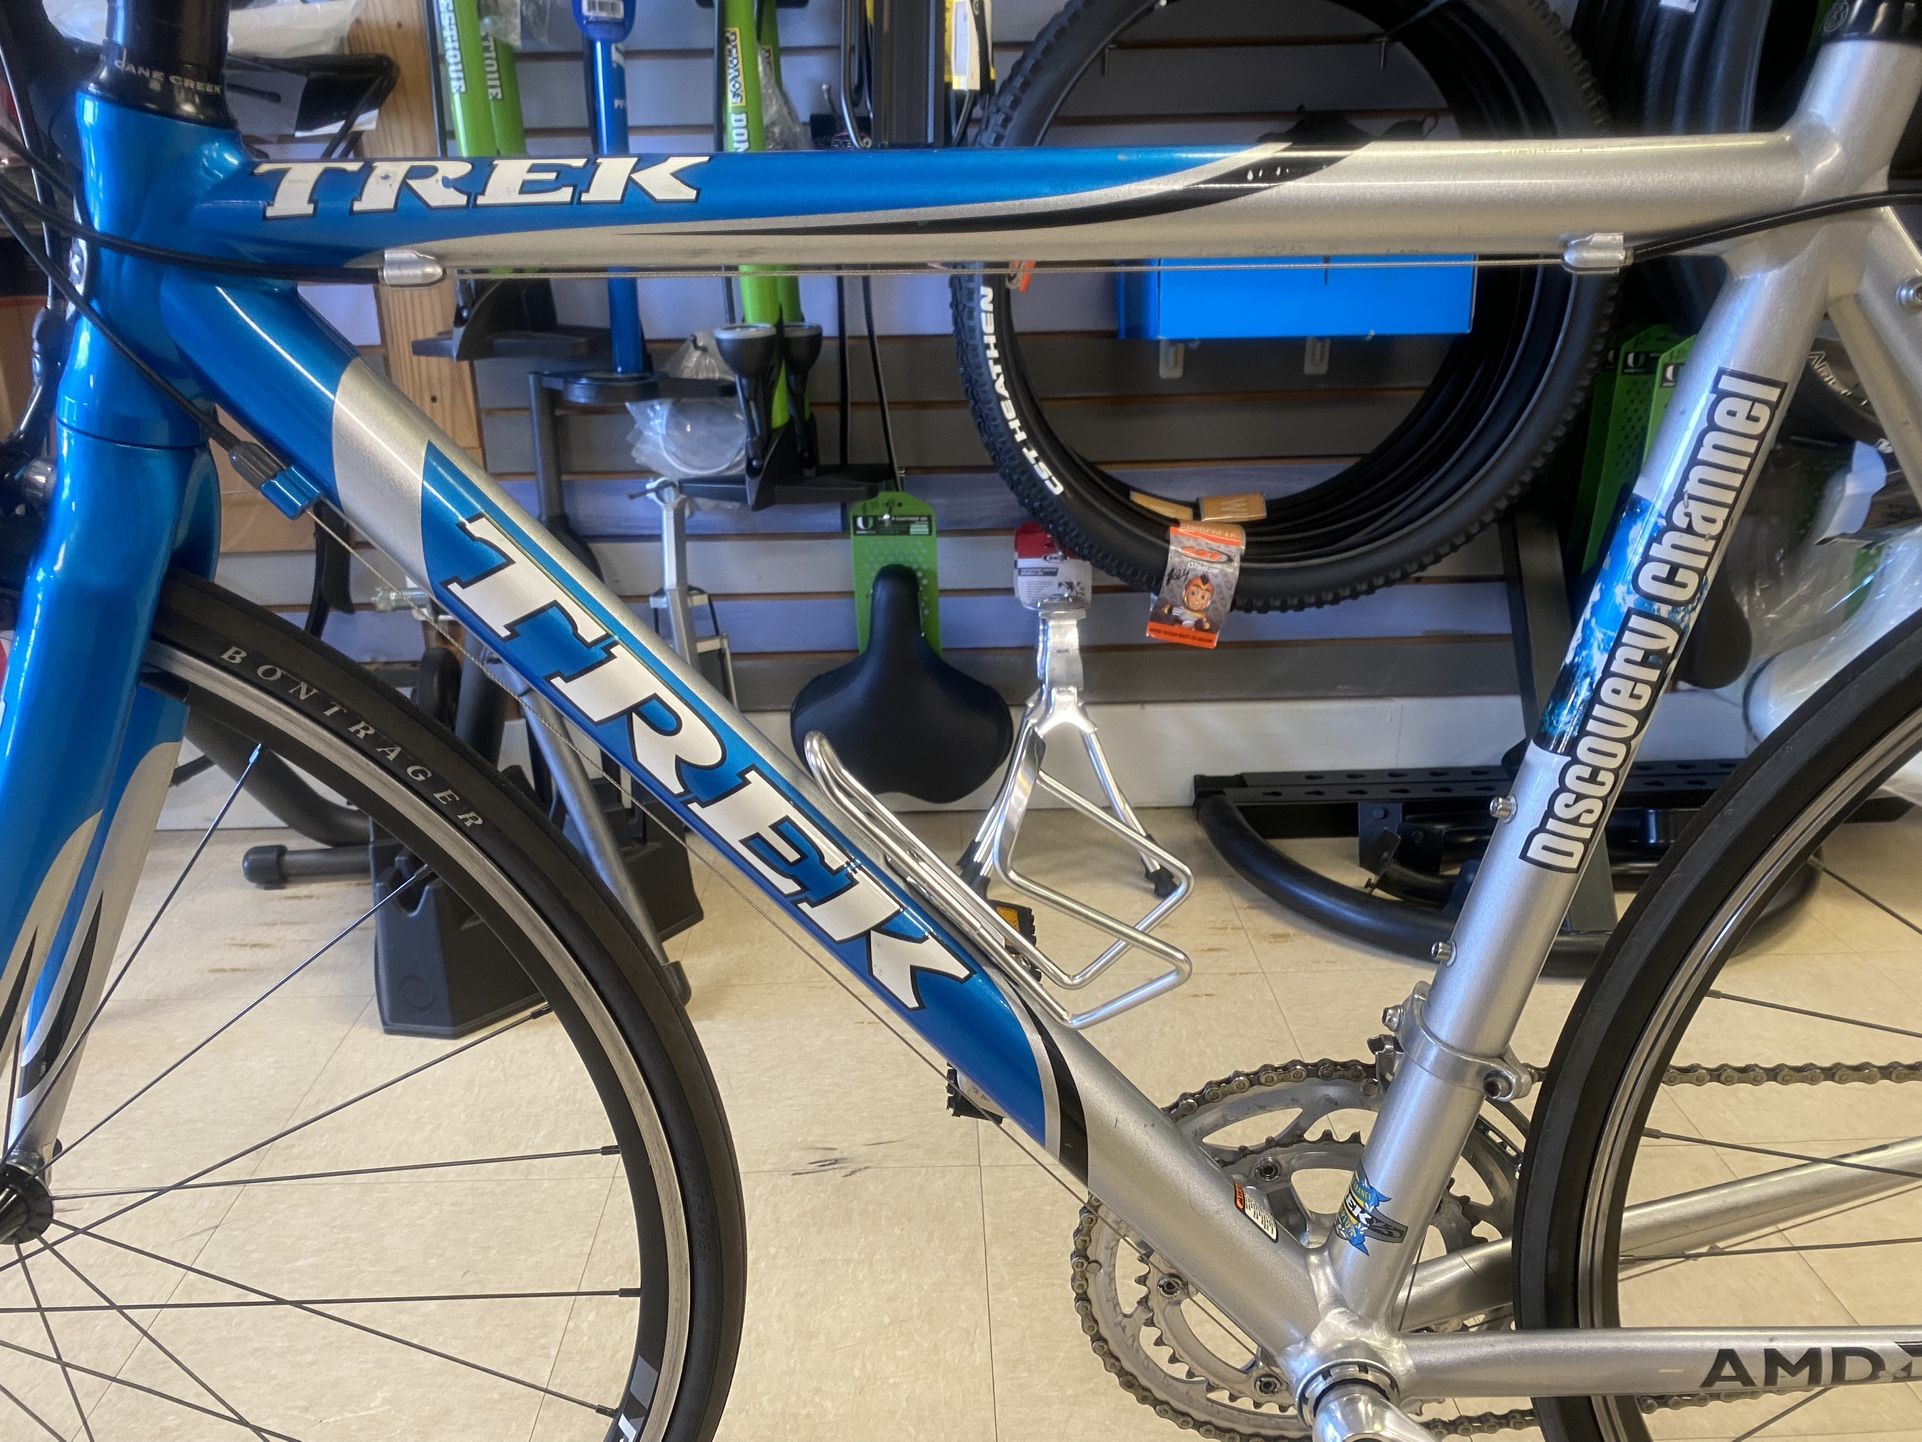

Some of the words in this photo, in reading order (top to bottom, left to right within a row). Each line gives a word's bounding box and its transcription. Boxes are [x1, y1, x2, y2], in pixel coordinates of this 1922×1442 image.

[168, 75, 221, 94] CREEK
[255, 156, 711, 219] TREK
[979, 286, 1027, 442] HEATHEN
[1022, 445, 1064, 496] CST
[1518, 606, 1684, 874] Discovery
[1632, 366, 1789, 607] Channel
[219, 646, 484, 827] BONTRAGER
[442, 513, 978, 1011] TREK
[1700, 1346, 1886, 1388] AMD
